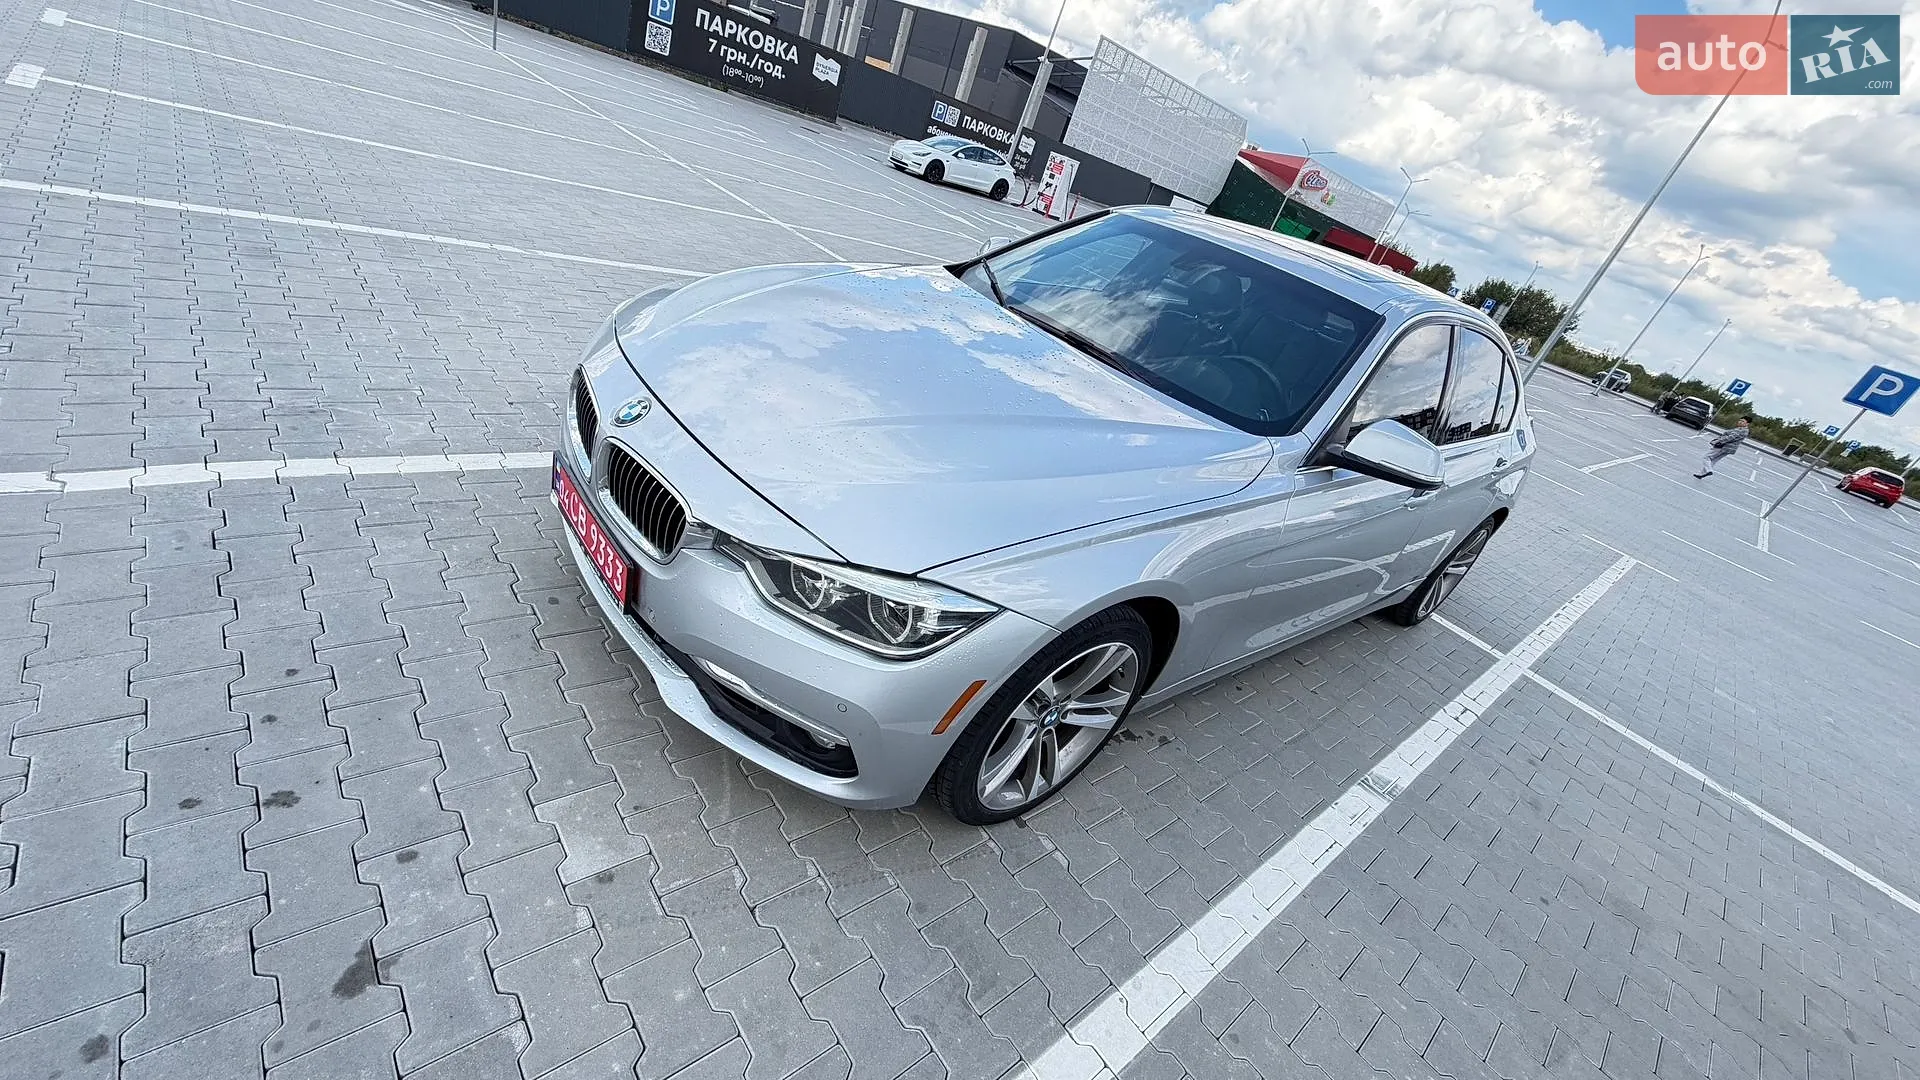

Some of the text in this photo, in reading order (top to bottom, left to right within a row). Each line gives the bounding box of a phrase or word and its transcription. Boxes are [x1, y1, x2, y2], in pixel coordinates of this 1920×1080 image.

[695, 8, 799, 65] ПАРКОВКА
[707, 38, 719, 53] 7
[961, 115, 1016, 145] ПАРКОВКА
[1858, 373, 1905, 402] P
[590, 523, 623, 592] 9333
